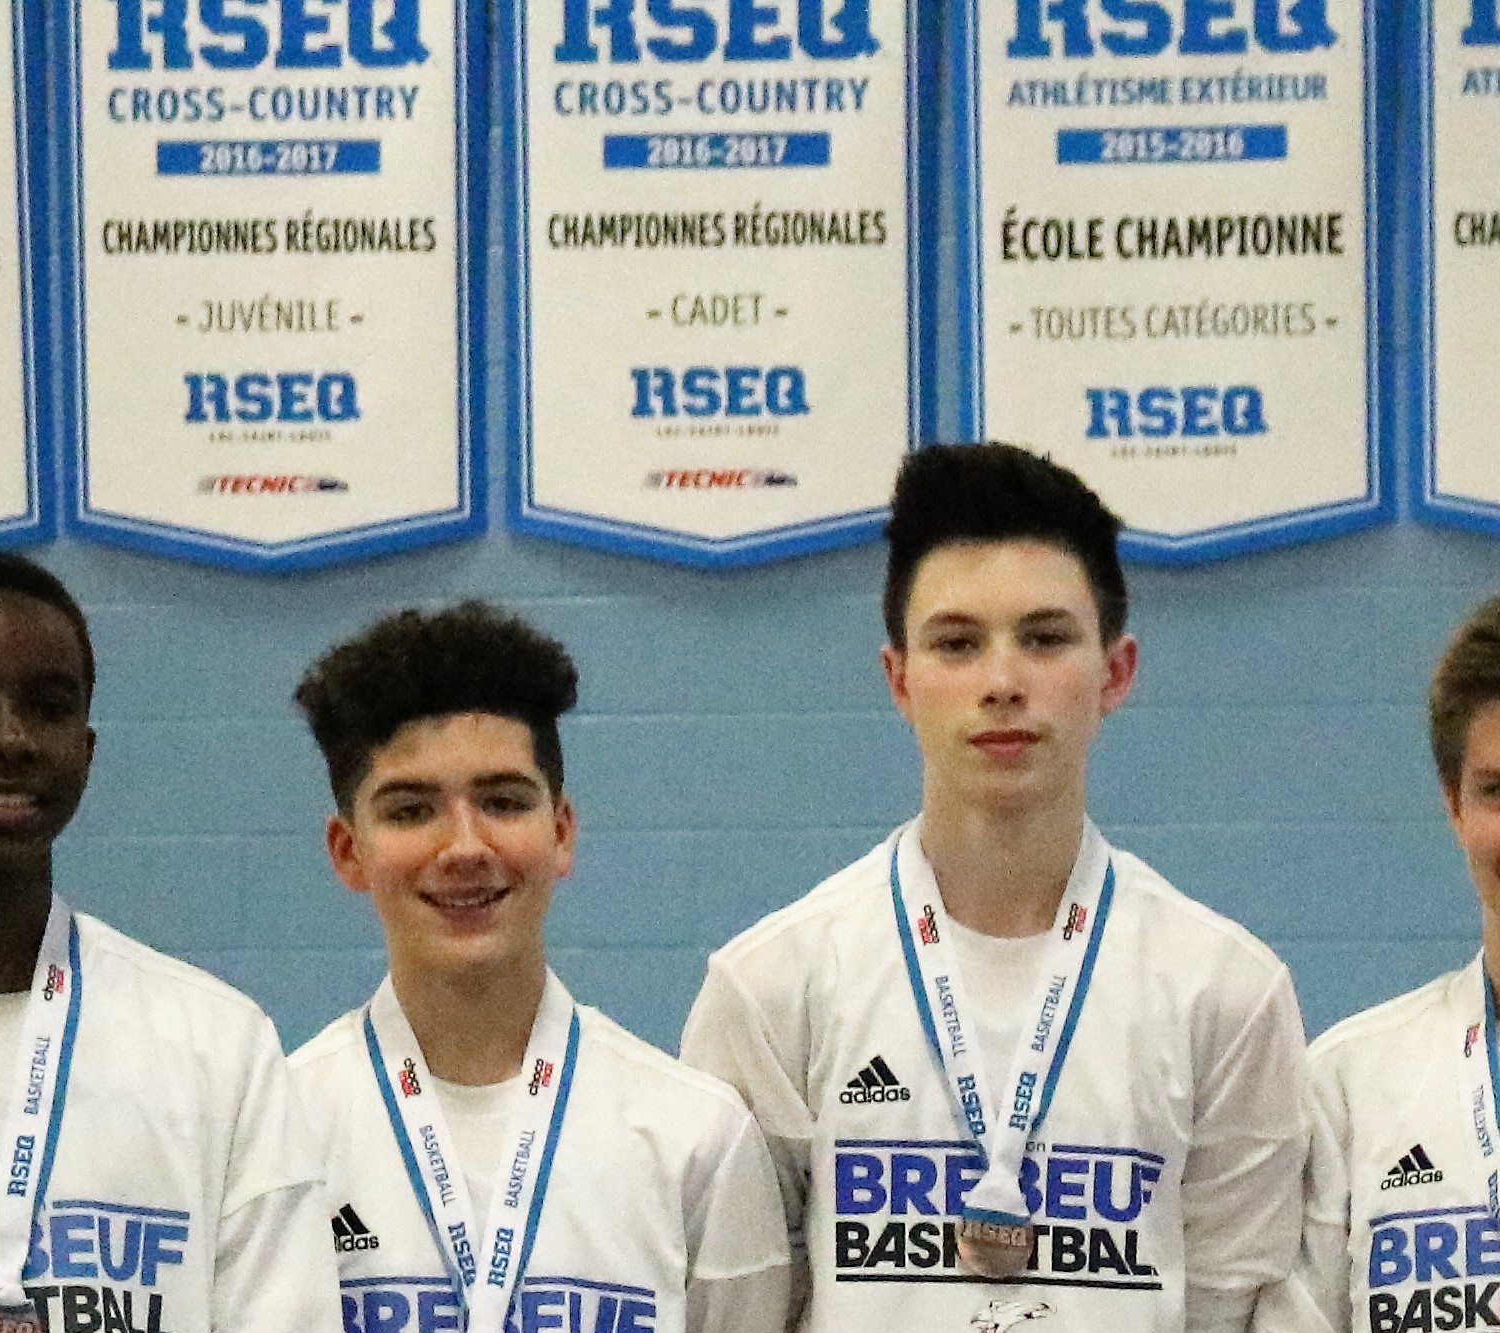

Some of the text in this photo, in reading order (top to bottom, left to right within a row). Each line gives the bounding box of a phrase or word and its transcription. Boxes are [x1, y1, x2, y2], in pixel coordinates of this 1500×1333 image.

[108, 0, 430, 70] RSEQ
[108, 86, 419, 122] CROSS-COUNTRY
[554, 79, 868, 115] CROSS-COUNTRY
[1007, 69, 1327, 106] ATHLÉTISME EXTÉRIEUR
[200, 145, 336, 174] 2016-2017
[647, 138, 787, 166] 2016-2017
[1102, 131, 1244, 160] 2015-2016
[102, 210, 436, 254] CHAMPIONNES RÉGIONALES
[548, 203, 887, 247] CHAMPIONNES RÉGIONALES
[1002, 209, 1343, 260] ÉCOLE CHAMPIONNE
[185, 374, 360, 422] RSEQ
[632, 368, 809, 417] RSEQ
[1086, 387, 1268, 437] RSEQ
[935, 974, 986, 1136] BASKETBALL RSEQ
[1009, 974, 1068, 1131] BASKETBALL RSEQ
[6, 1036, 51, 1197] BASKETBALL RSEQ
[839, 1087, 910, 1104] adidas
[420, 1124, 457, 1208] BASKETBALL
[1381, 1169, 1443, 1190] adidas
[488, 1130, 535, 1289] BASKETBALL RSEQ
